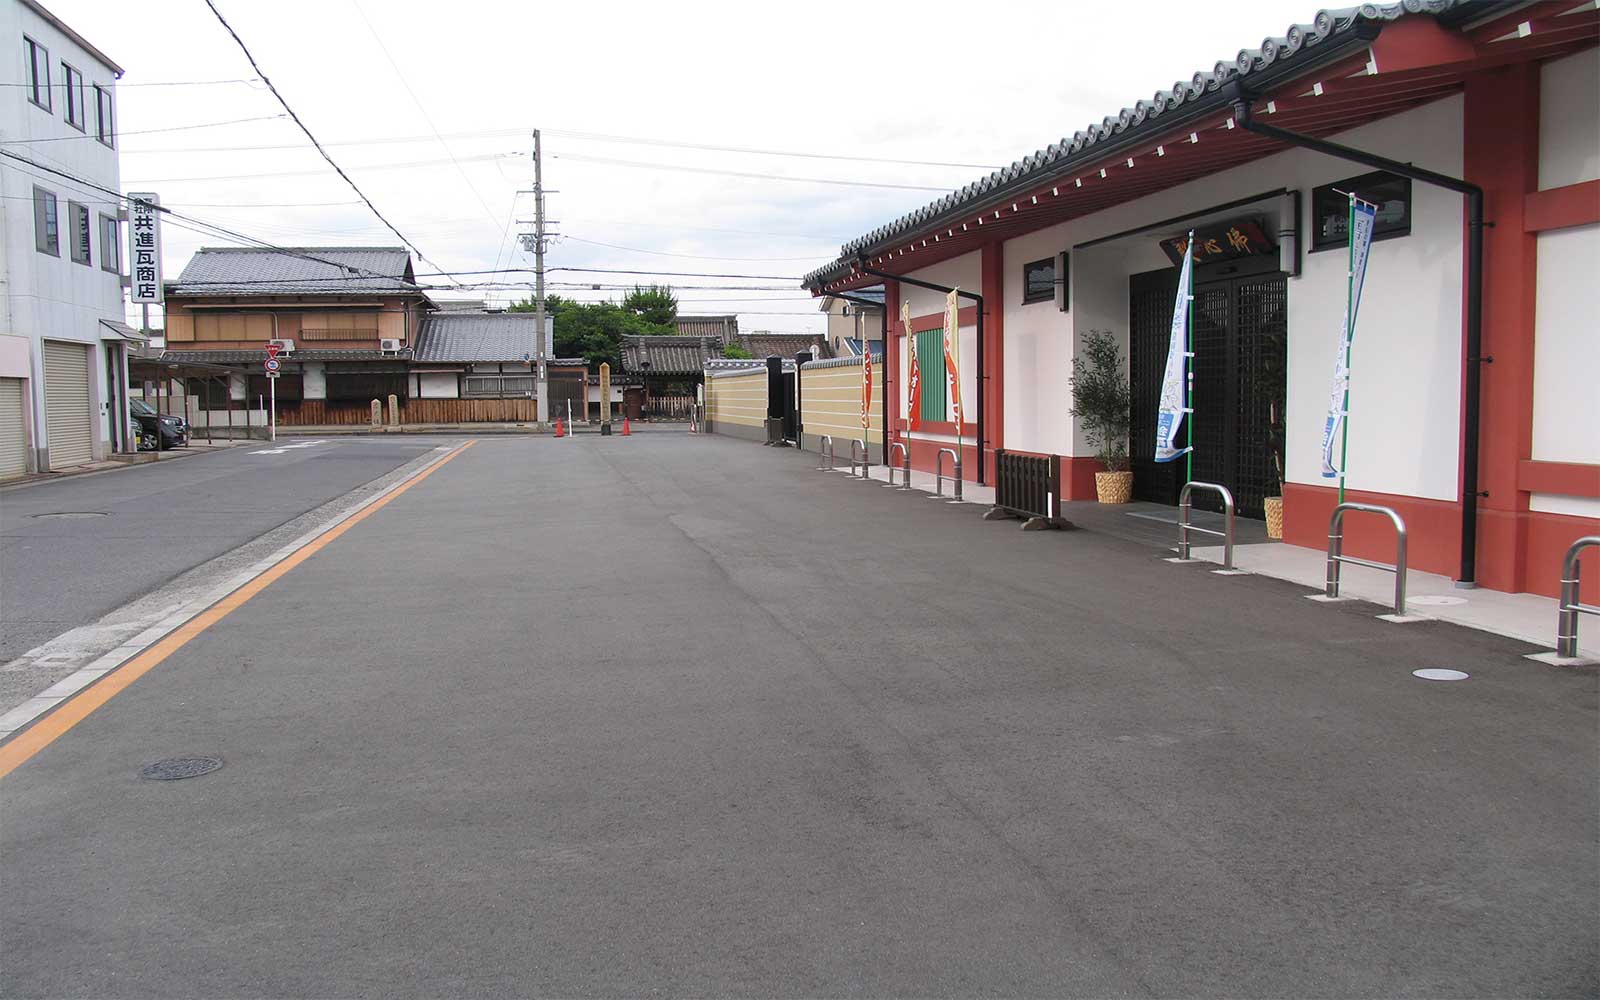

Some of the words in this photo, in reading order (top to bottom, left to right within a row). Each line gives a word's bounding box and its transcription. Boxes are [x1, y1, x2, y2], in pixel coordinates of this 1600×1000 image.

[134, 216, 156, 299] 共進瓦商店
